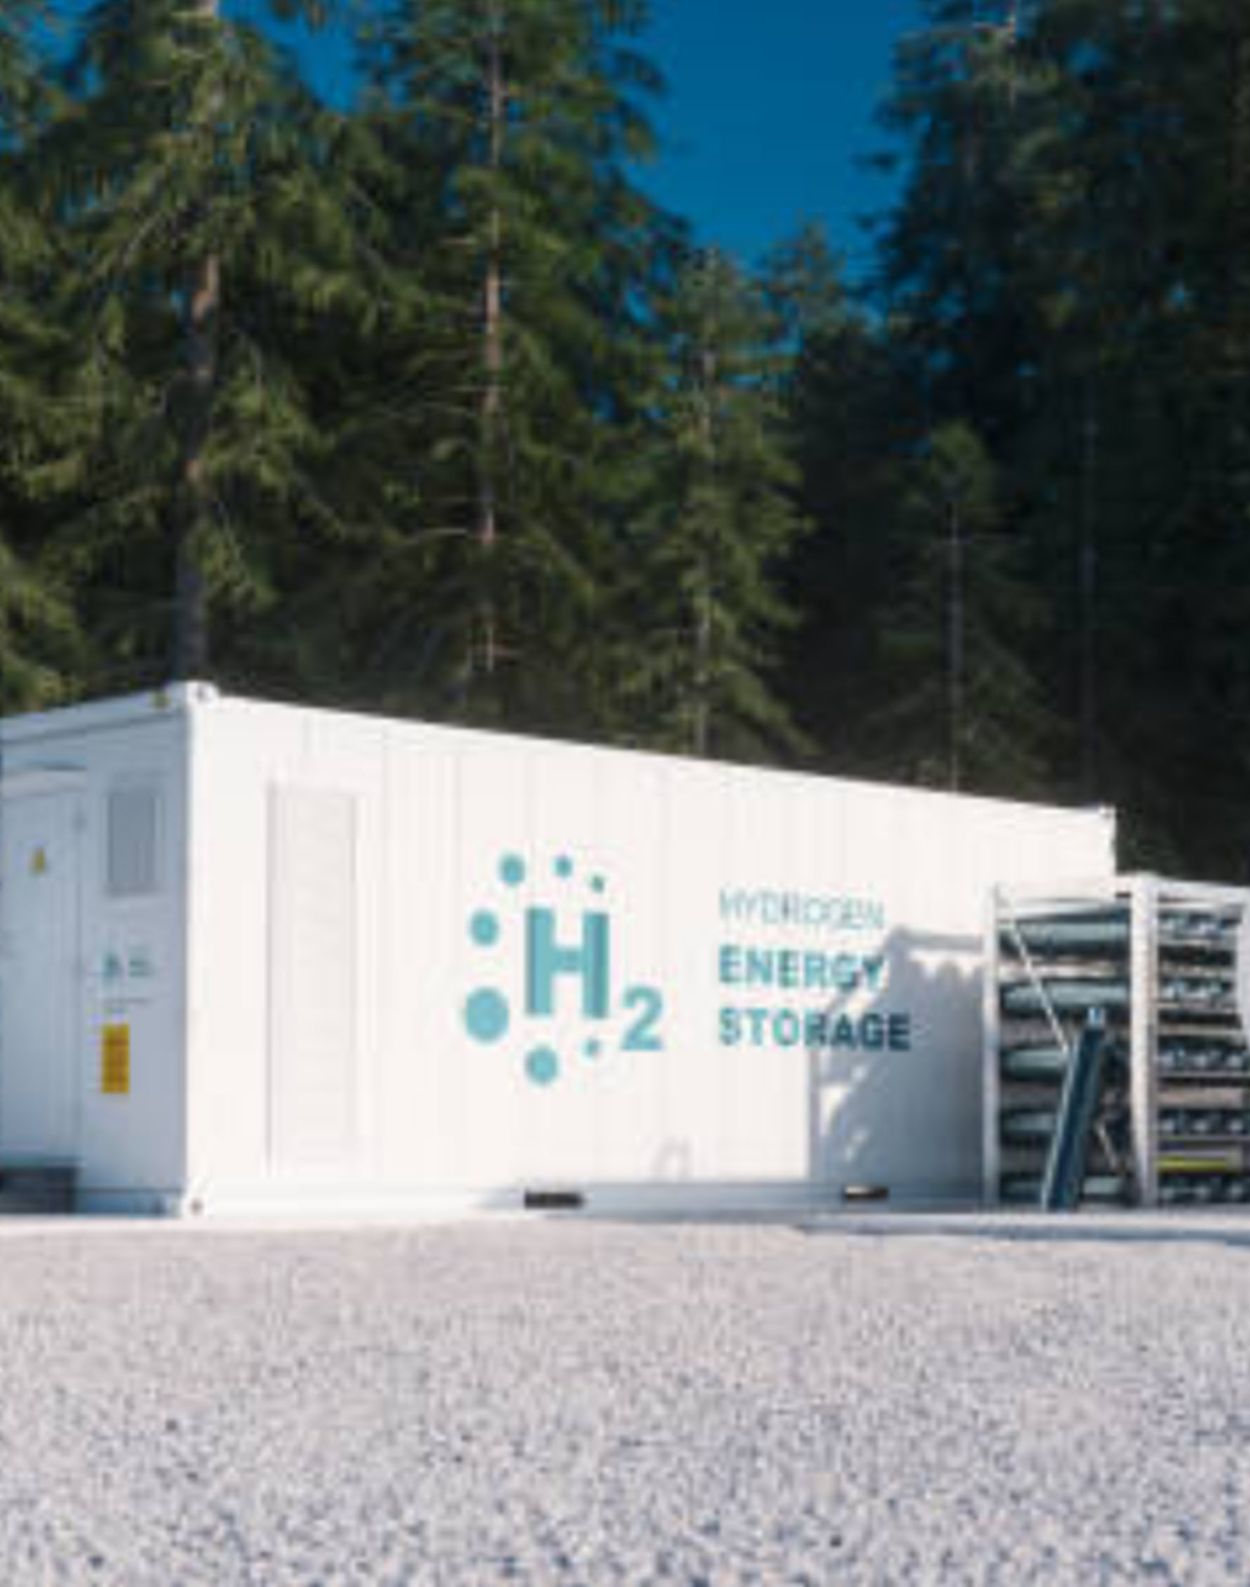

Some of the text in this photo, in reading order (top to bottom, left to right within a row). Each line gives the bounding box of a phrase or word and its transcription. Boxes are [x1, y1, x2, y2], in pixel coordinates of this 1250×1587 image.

[719, 888, 885, 929] HYDROGEN
[719, 944, 885, 992] ENERGY
[719, 1007, 911, 1052] STORAGE
